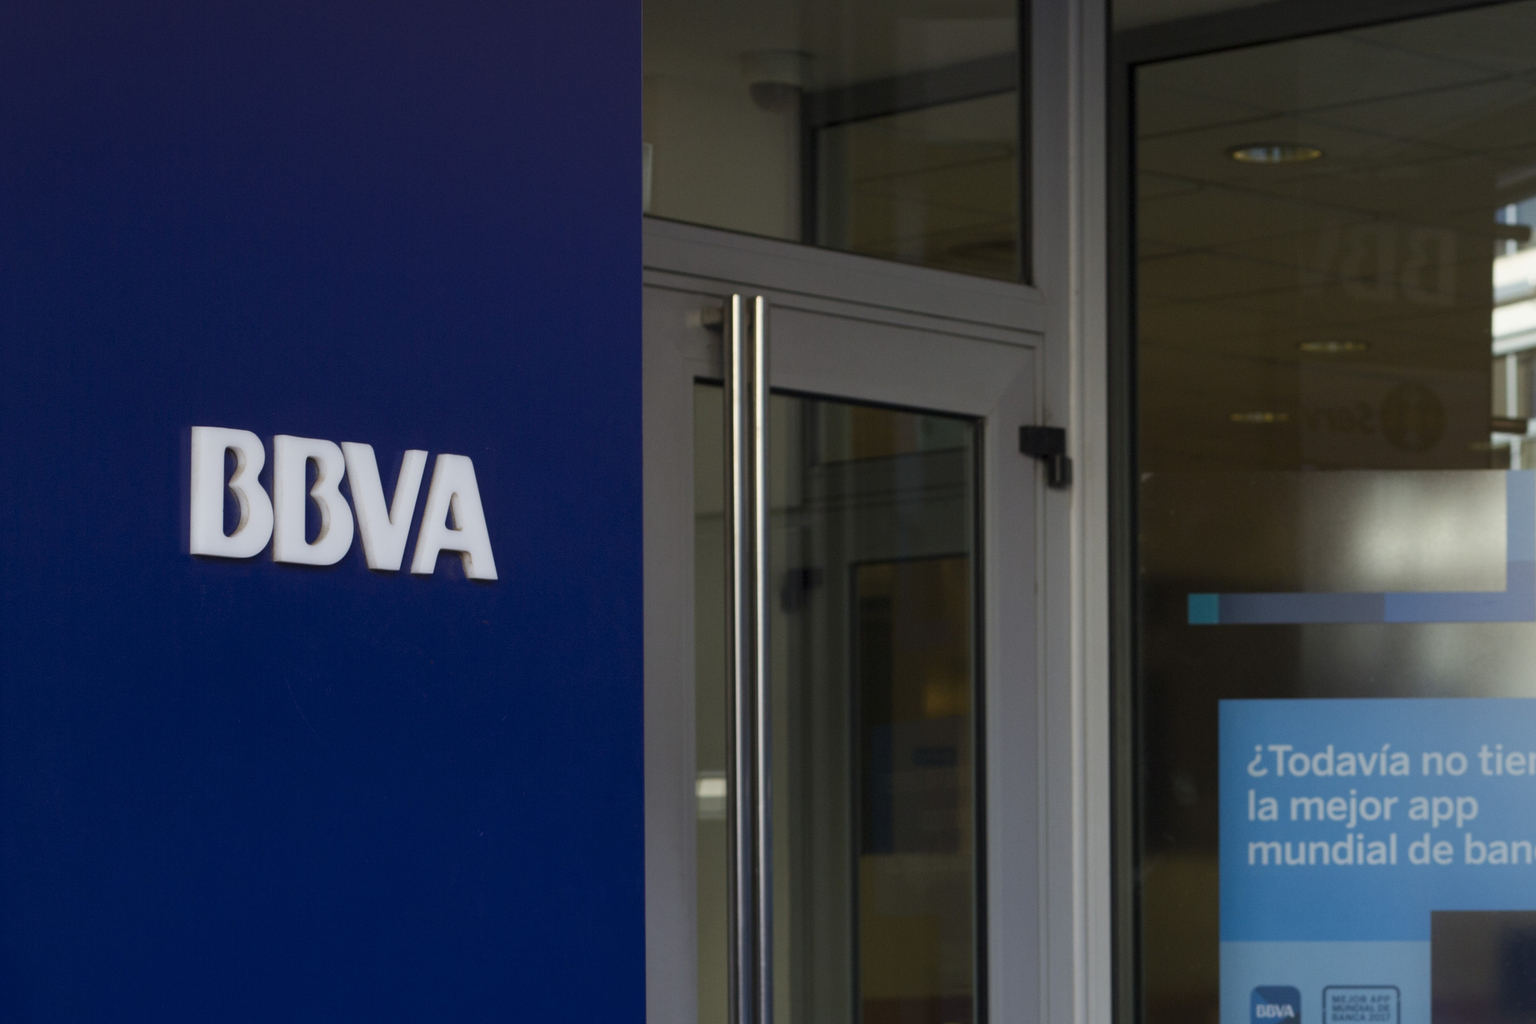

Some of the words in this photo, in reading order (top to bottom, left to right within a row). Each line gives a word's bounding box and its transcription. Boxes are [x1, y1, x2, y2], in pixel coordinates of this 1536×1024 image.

[190, 425, 498, 580] BBVA
[1246, 743, 1411, 777] ¿Todavía
[1421, 750, 1468, 776] no
[1247, 790, 1278, 821] la
[1290, 790, 1399, 829] mejor
[1408, 797, 1479, 828] app
[1247, 833, 1397, 866] mundial
[1408, 833, 1454, 865] de
[1255, 1004, 1296, 1019] BBVA
